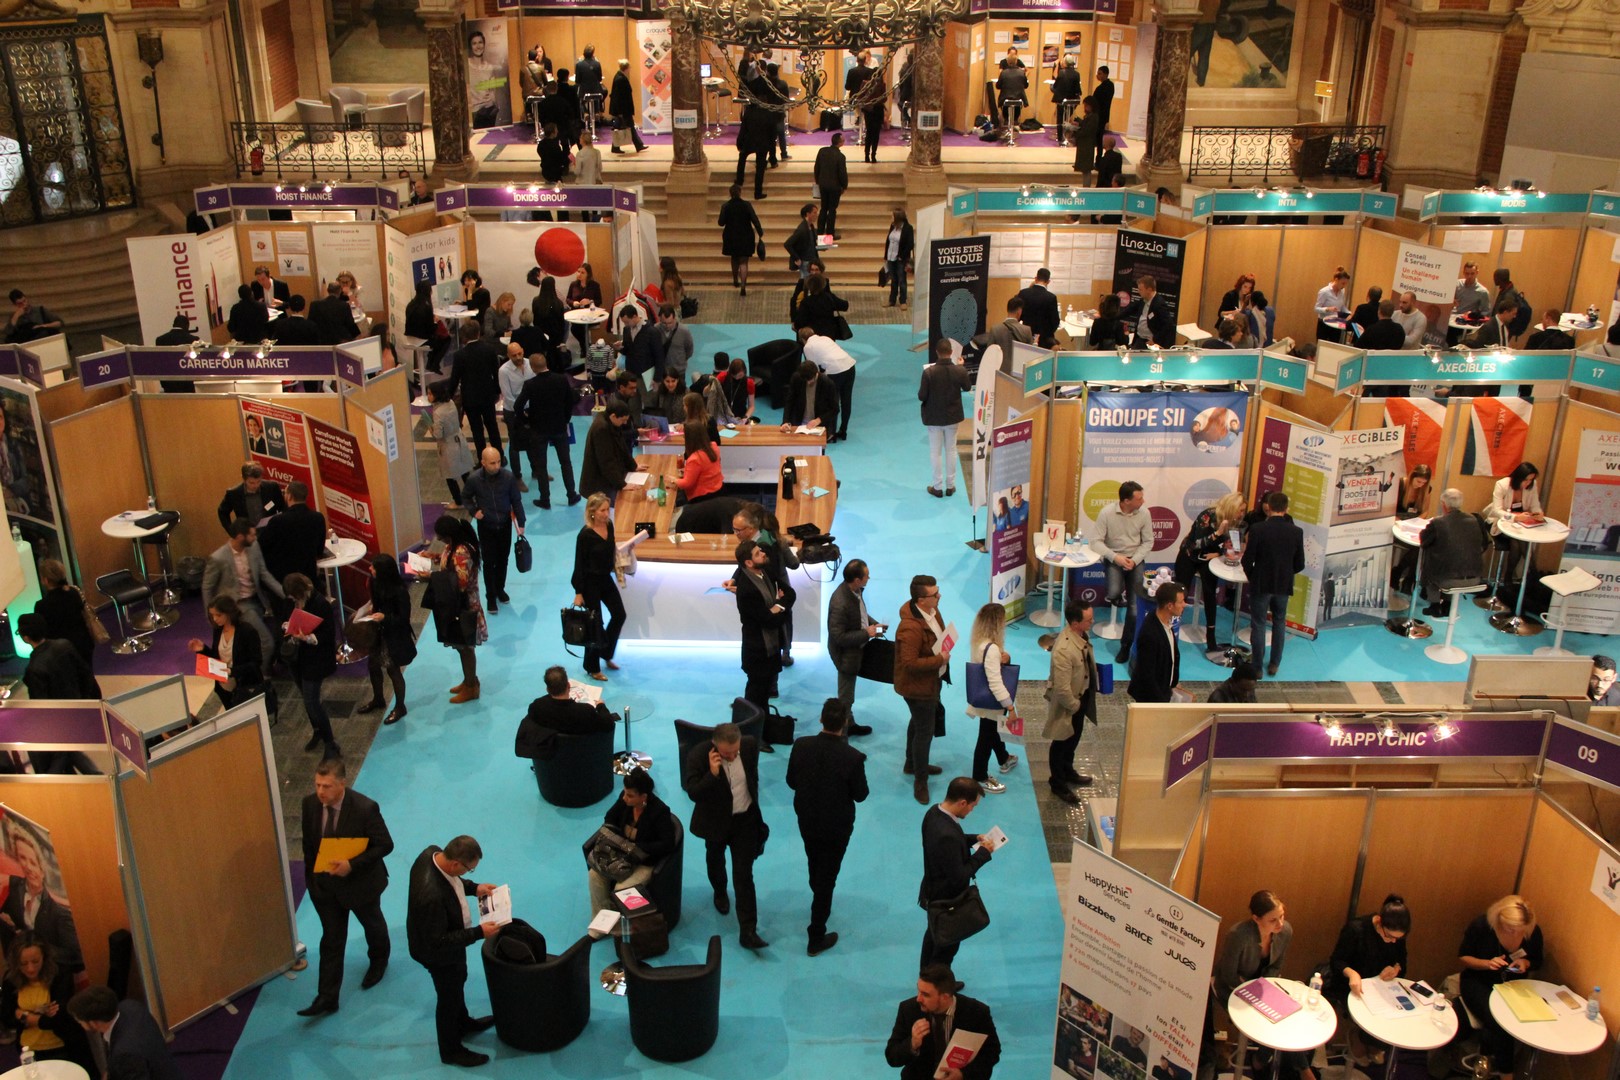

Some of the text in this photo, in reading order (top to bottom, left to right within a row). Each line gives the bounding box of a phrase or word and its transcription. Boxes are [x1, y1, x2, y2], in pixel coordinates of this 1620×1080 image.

[208, 196, 217, 205] 30
[275, 192, 333, 202] HOIST FINANCE
[446, 197, 455, 205] 29
[540, 194, 568, 203] GROUP
[1016, 197, 1073, 206] E-CONSULTING
[1277, 198, 1297, 207] INTM
[1137, 200, 1145, 209] 28
[1374, 201, 1384, 209] 27
[1500, 199, 1527, 208] MODIS
[411, 236, 456, 254] act for kids
[938, 244, 984, 256] VOUS ETES
[1405, 251, 1427, 260] Conseil
[1409, 258, 1434, 269] Services
[1401, 273, 1422, 282] humain
[1411, 267, 1440, 280] challenge
[171, 241, 199, 325] Finance
[1400, 283, 1443, 298] Rejoignez-nous
[1424, 331, 1442, 344] ntm
[179, 358, 290, 369] CARREFOUR MARKET
[1150, 363, 1163, 374] SII
[1437, 363, 1497, 373] AXECIBLES
[98, 364, 111, 376] 20
[1034, 370, 1042, 381] 18
[1277, 366, 1289, 378] 18
[1346, 368, 1353, 380] 17
[1592, 367, 1605, 379] 17
[1088, 407, 1186, 427] GROUPE SII
[976, 428, 987, 461] RK
[1271, 441, 1281, 449] NOS
[267, 466, 294, 483] Vivez
[1346, 477, 1378, 487] VENDEZ
[1152, 521, 1174, 529] VATION
[122, 732, 132, 751] 10
[1330, 731, 1428, 747] HAPPYCHIC
[1181, 747, 1193, 765] 09
[1577, 745, 1598, 764] 09
[1084, 871, 1131, 899] Happychic
[1078, 894, 1116, 923] Bizzbee
[1077, 919, 1121, 949] Notre Ambition
[1125, 923, 1154, 946] BRICE
[1156, 913, 1179, 932] Gentle
[1180, 927, 1205, 948] Factory
[1145, 1024, 1152, 1034] ta
[1171, 1016, 1187, 1031] Et si
[1156, 1014, 1196, 1048] ton TALENT
